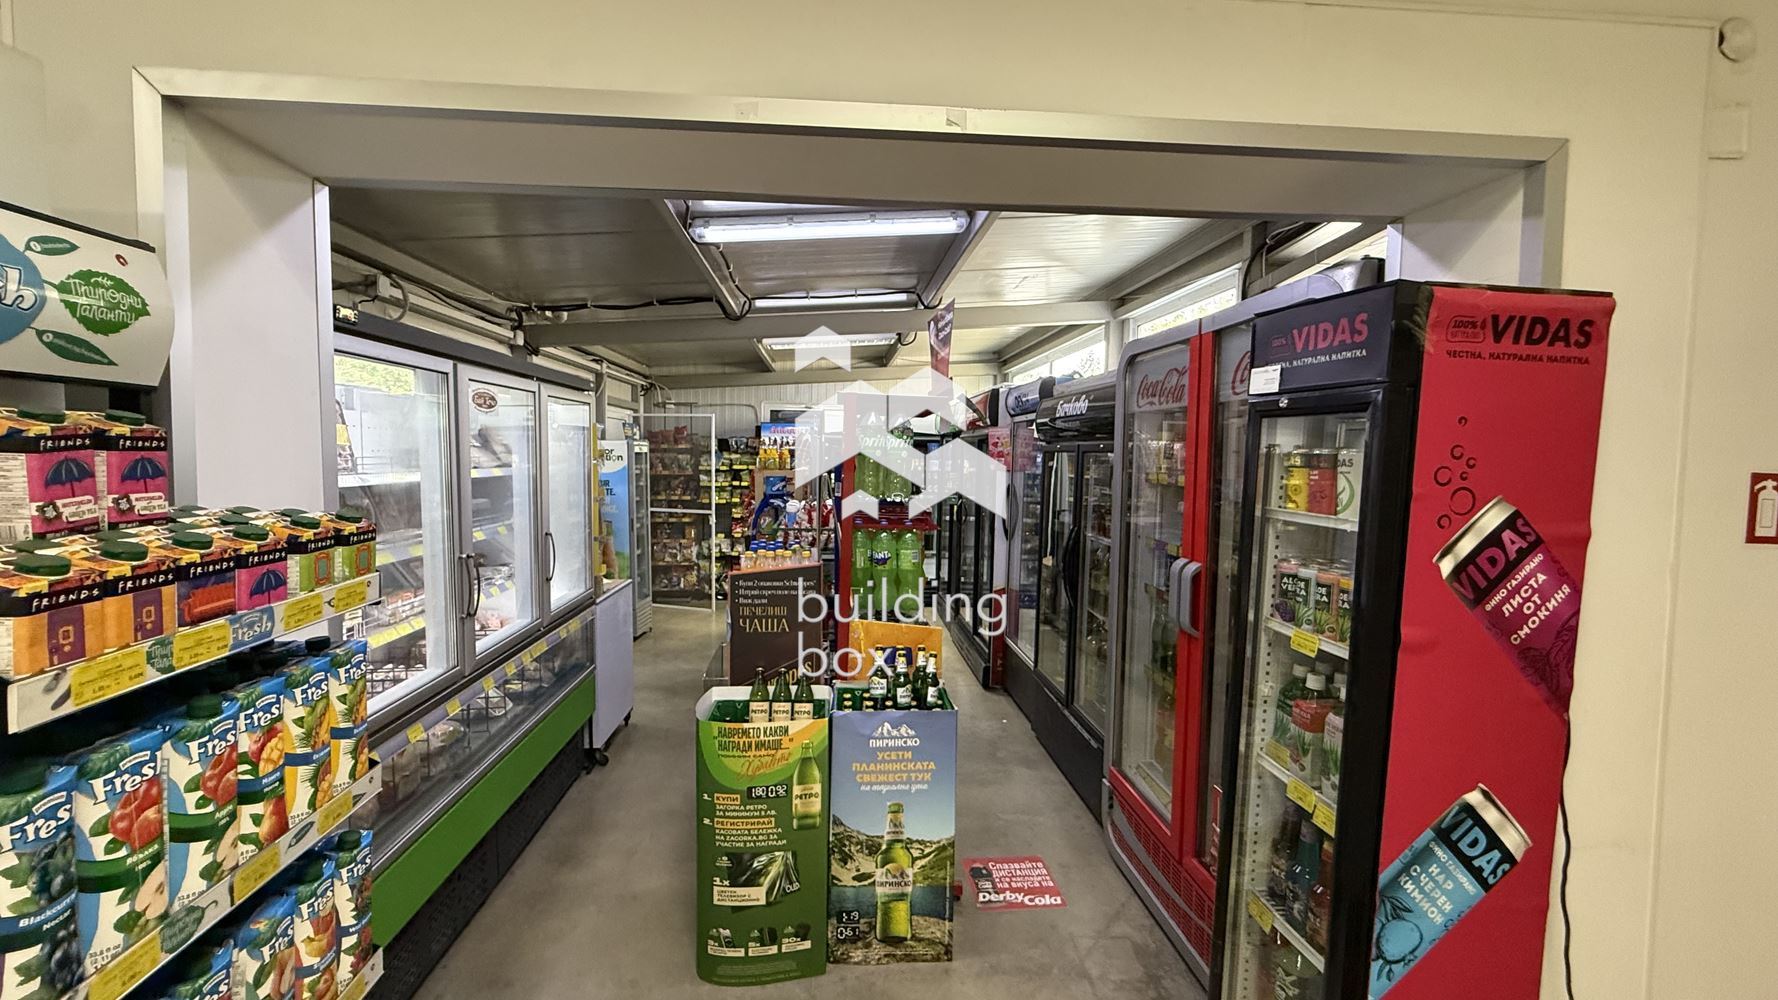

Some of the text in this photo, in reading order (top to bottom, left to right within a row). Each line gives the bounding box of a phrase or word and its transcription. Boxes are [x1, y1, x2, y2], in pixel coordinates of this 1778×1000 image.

[1451, 319, 1479, 330] 100%
[1490, 313, 1595, 350] VIDAS
[1291, 312, 1369, 353] VIDAS
[1292, 348, 1367, 367] НАТУРАЛНА НАПИТКА
[1446, 350, 1590, 366] ЧЕСТНА, НАТУРАЛНА НАПИТКА
[40, 438, 91, 450] FRIENDS
[119, 439, 166, 450] FRIENDS
[350, 532, 377, 543] FRIENDS
[307, 540, 335, 551] FRIENDS
[248, 551, 287, 566] FRIENDS
[1451, 516, 1538, 600] VIDAS
[190, 561, 235, 578] FRIENDS
[118, 573, 174, 593] FRIENDS
[1484, 553, 1544, 612] ФИНО ГАЗИРАНО
[32, 588, 100, 612] FRIENDS
[1501, 572, 1547, 618] ЛИСТА
[739, 606, 787, 616] ПЕЧЕЛИШ
[1522, 593, 1542, 616] ОТ
[1510, 584, 1571, 645] СМОКИНЯ
[739, 618, 790, 633] ЧАША
[763, 725, 789, 738] КАКВИ
[717, 740, 753, 753] НАГРАДИ
[869, 738, 920, 748] ПИРИНСКО
[876, 751, 912, 760] УСЕТИ
[852, 761, 936, 772] ПЛАНИНСКАТА
[855, 772, 932, 782] СВЕЖЕСТ ТУК
[715, 817, 773, 827] РЕГИСТРИРАЙ
[1438, 804, 1510, 886] VIDAS
[988, 860, 1044, 870] Спазвайте
[992, 868, 1048, 877] ДИСТАНЦИЯ
[1428, 840, 1477, 896] ФИНО ГАЗИРАНО
[877, 879, 911, 888] ПИРИНСКО
[1428, 863, 1454, 891] НАР
[1010, 881, 1040, 889] вкуса
[1409, 864, 1454, 914] С ЧЕРЕН
[1396, 873, 1445, 926] КИМИОН
